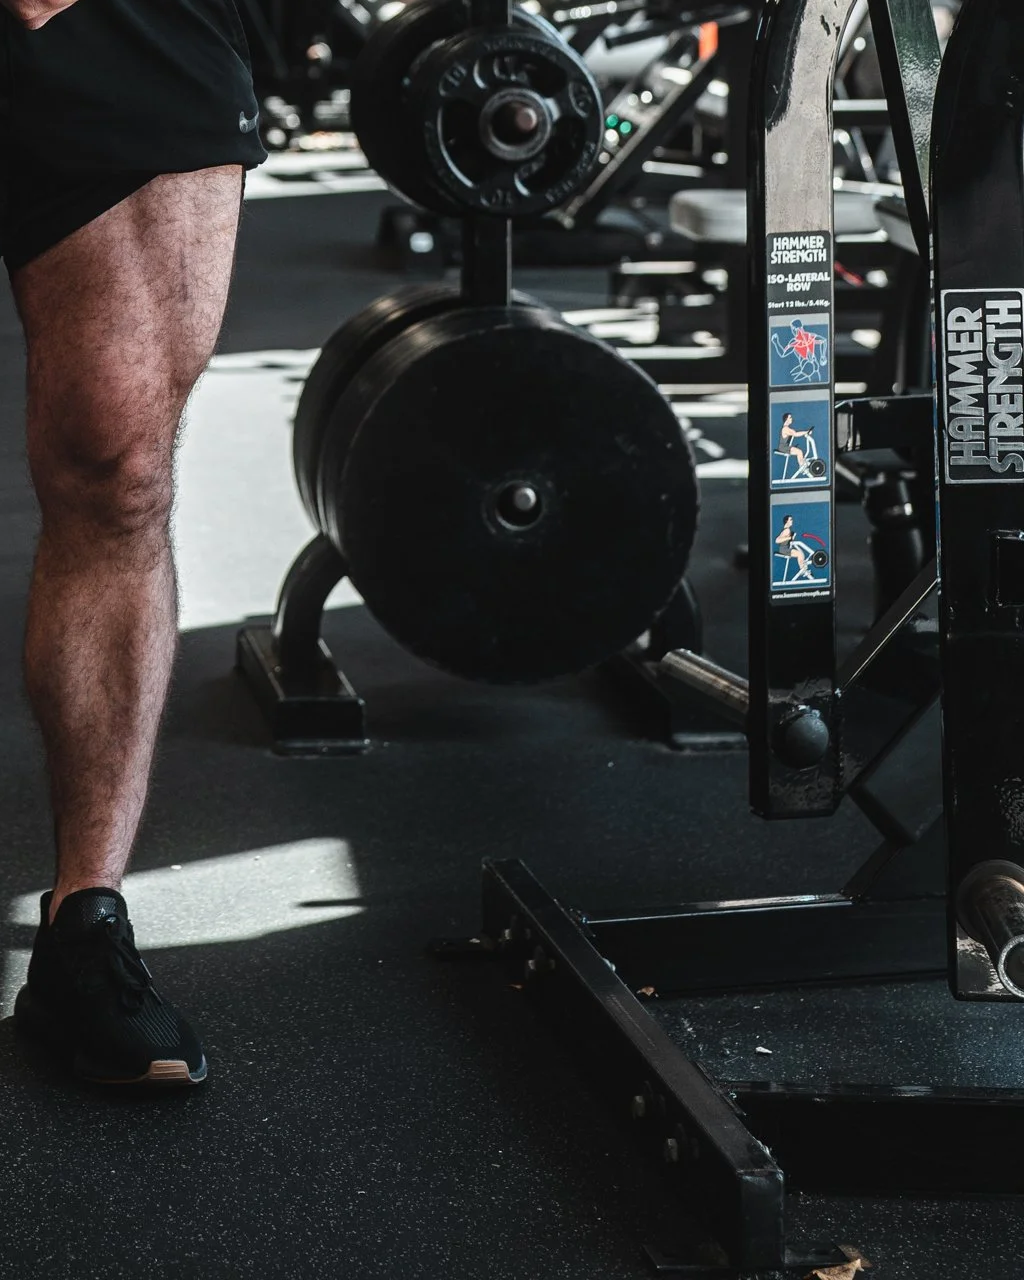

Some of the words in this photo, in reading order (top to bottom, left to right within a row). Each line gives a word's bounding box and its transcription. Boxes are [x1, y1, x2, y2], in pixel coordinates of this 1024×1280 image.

[773, 236, 824, 251] HAMMER
[770, 249, 826, 264] STRENGTH
[767, 272, 830, 284] ISO-LATERAL
[786, 282, 811, 292] ROW
[946, 306, 987, 466] HAMMER
[985, 299, 1024, 473] STRENGTH
